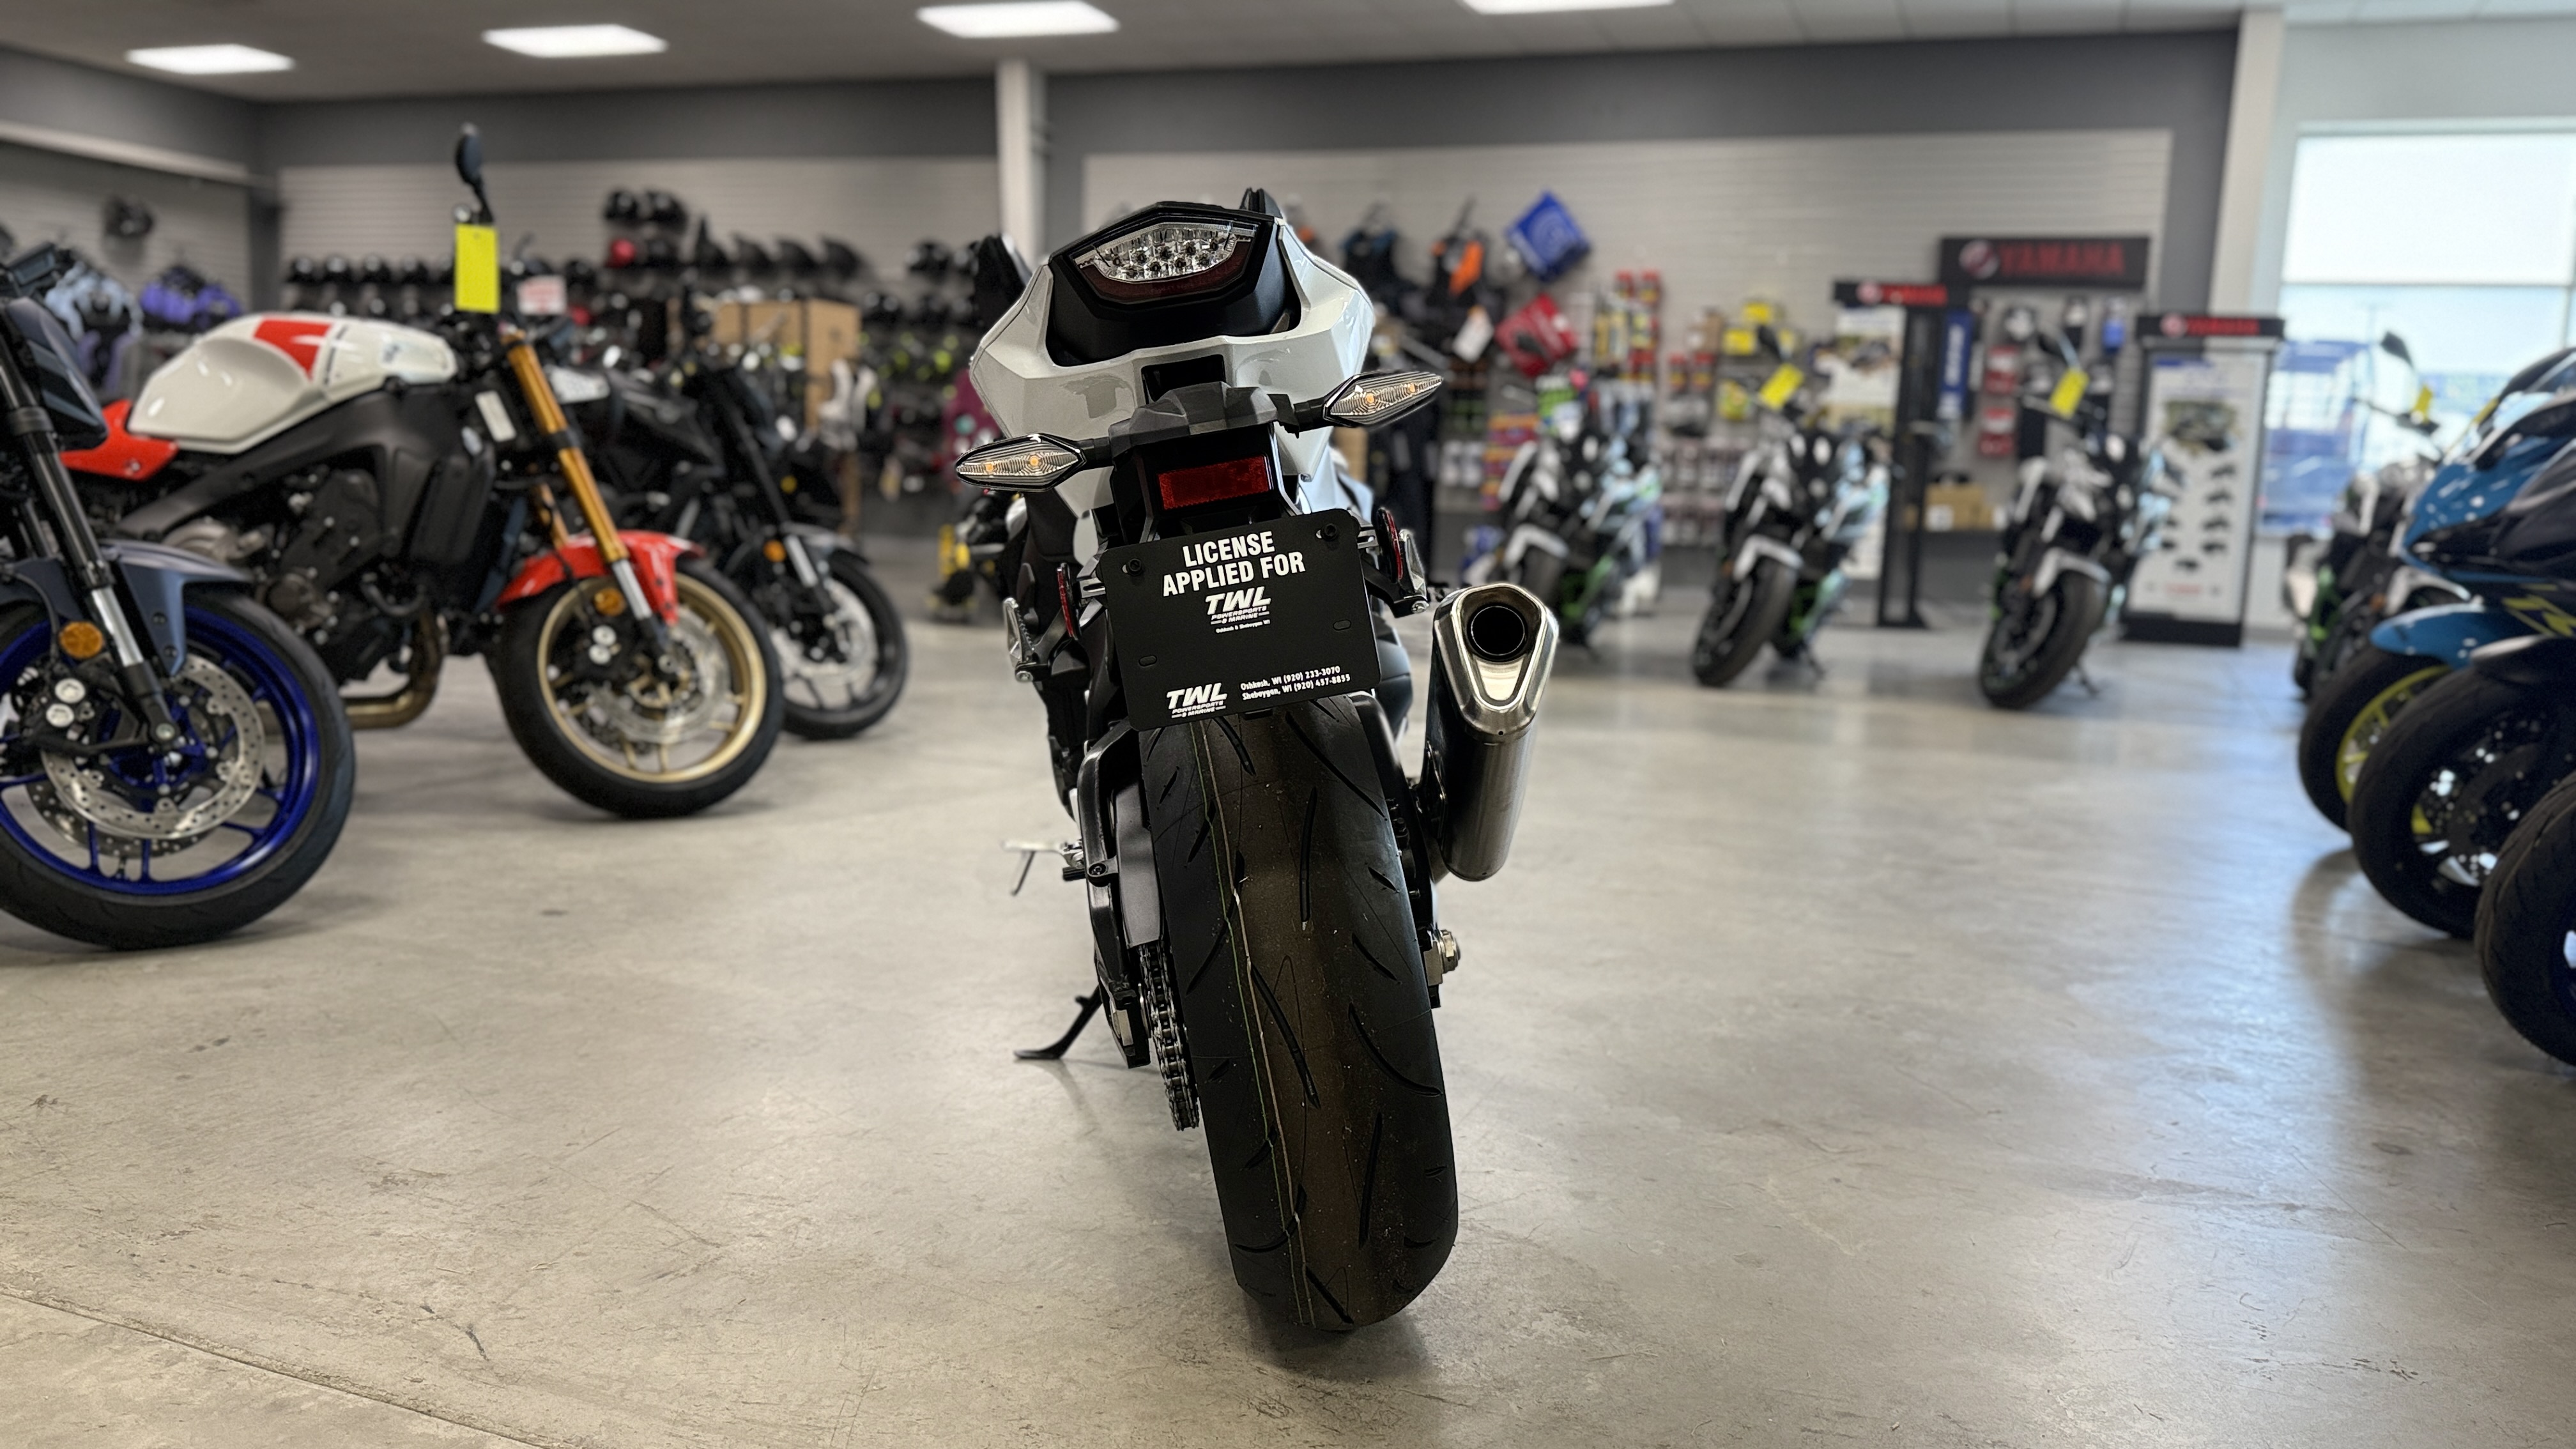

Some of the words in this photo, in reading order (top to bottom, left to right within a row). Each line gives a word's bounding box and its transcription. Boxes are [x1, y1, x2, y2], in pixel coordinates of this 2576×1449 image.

[1183, 531, 1275, 567] LICENSE
[1163, 560, 1254, 597] APPLIED
[1260, 551, 1306, 579] FOR
[1205, 586, 1271, 615] TWL
[1211, 606, 1267, 620] POWERSPORTS
[1228, 612, 1258, 622] MARINE
[1240, 678, 1270, 691] Oshkosh,
[1271, 676, 1282, 685] WI
[1284, 672, 1303, 684] (920)
[1305, 666, 1340, 679] 233-3070
[1242, 688, 1281, 700] Sheboygan,
[1282, 684, 1292, 693] WI
[1294, 680, 1314, 692] (920)
[1315, 673, 1351, 687] 457-8855
[1166, 682, 1228, 709] TWL
[1172, 700, 1223, 714] POWERSPORTS
[1188, 707, 1215, 716] MARINE
